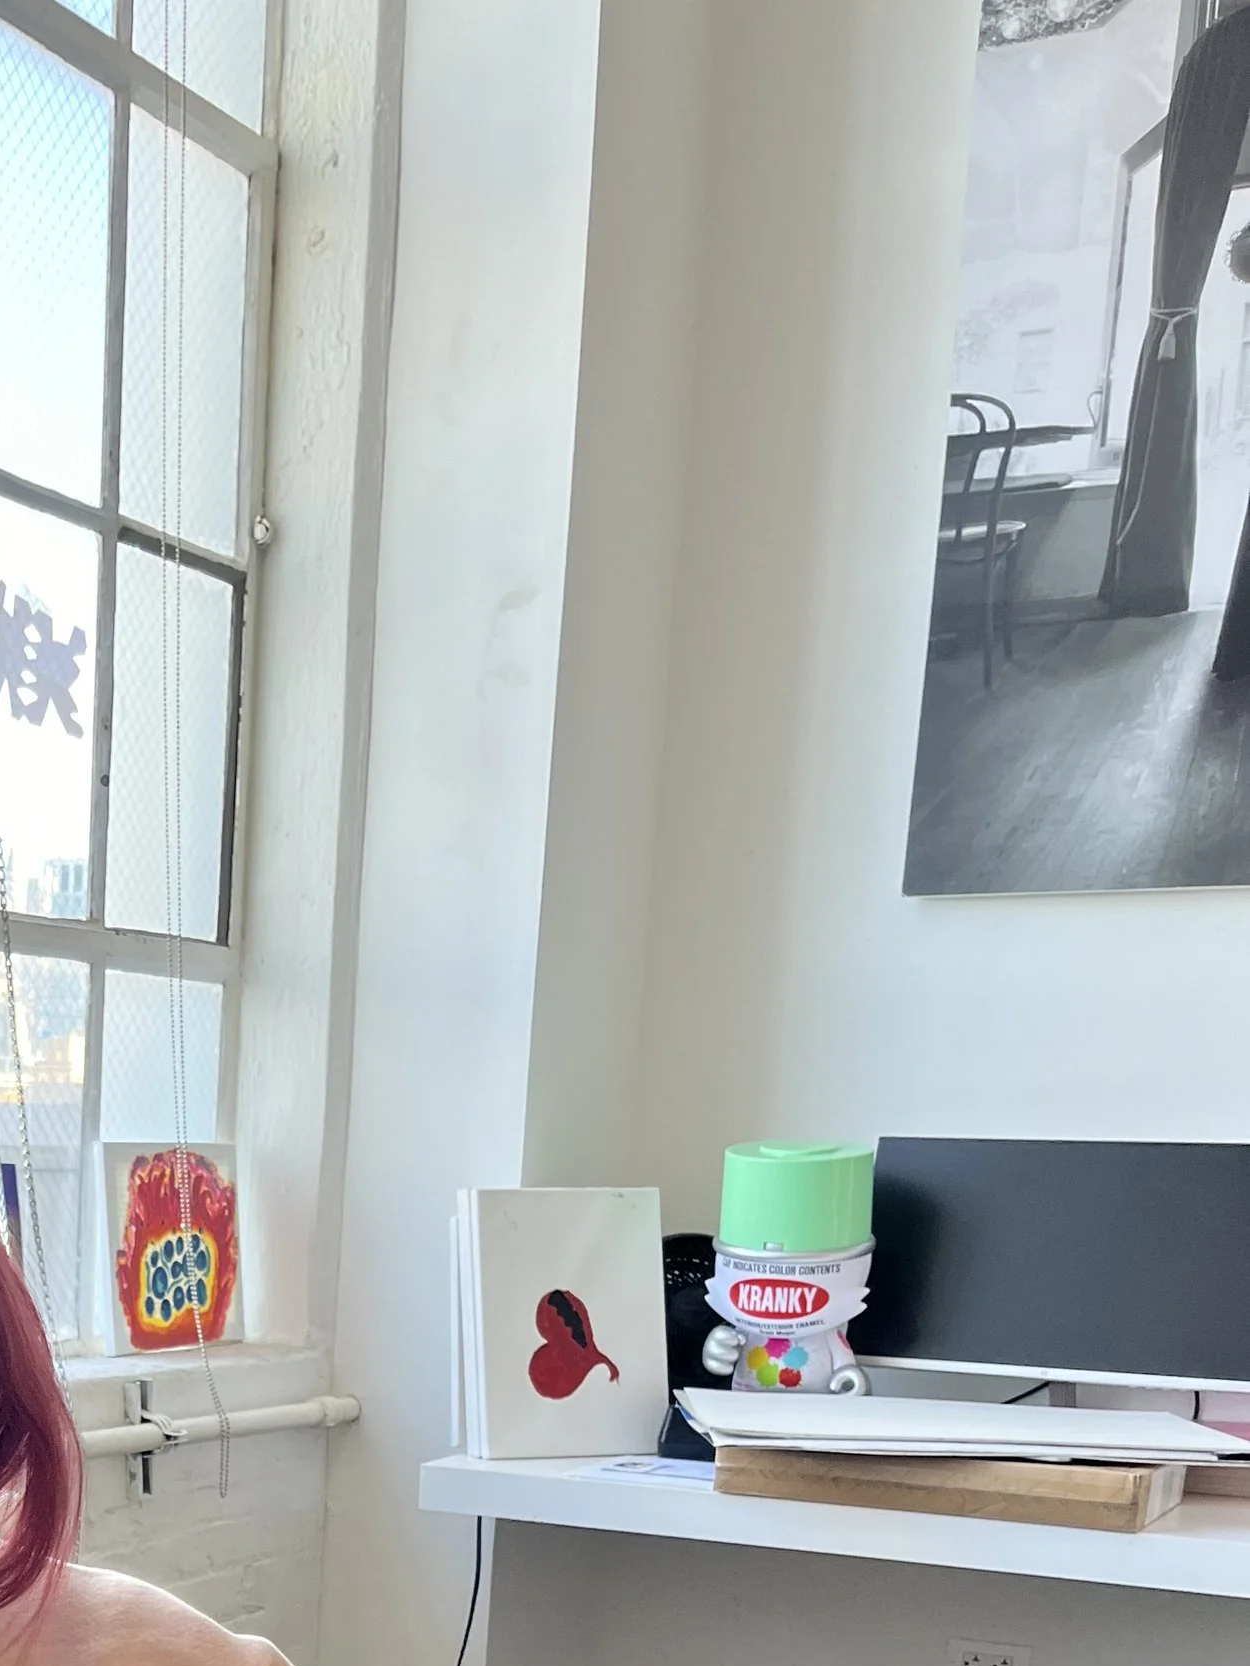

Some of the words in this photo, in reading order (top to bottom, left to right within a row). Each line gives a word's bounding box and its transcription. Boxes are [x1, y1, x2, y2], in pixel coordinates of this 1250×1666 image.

[732, 1260, 767, 1273] INDICATES
[768, 1264, 796, 1275] COLOR
[798, 1263, 841, 1275] CONTENTS
[737, 1283, 818, 1314] KRANKY
